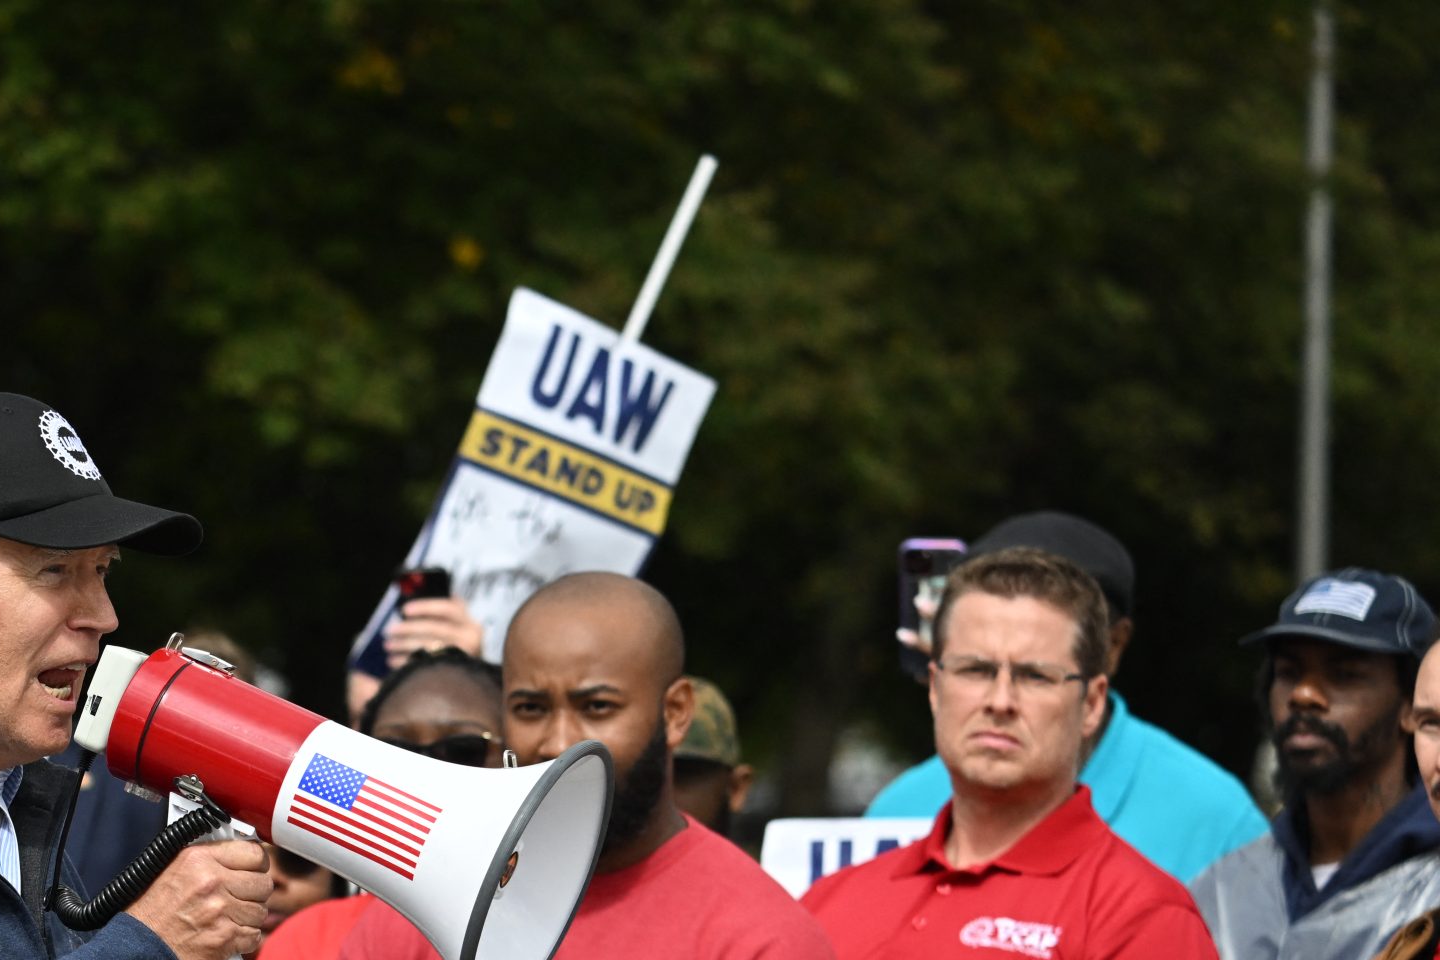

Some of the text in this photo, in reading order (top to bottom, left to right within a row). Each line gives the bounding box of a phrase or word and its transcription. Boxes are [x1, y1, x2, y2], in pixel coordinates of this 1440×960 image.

[530, 324, 675, 454] UAW
[479, 427, 656, 516] STAND UP
